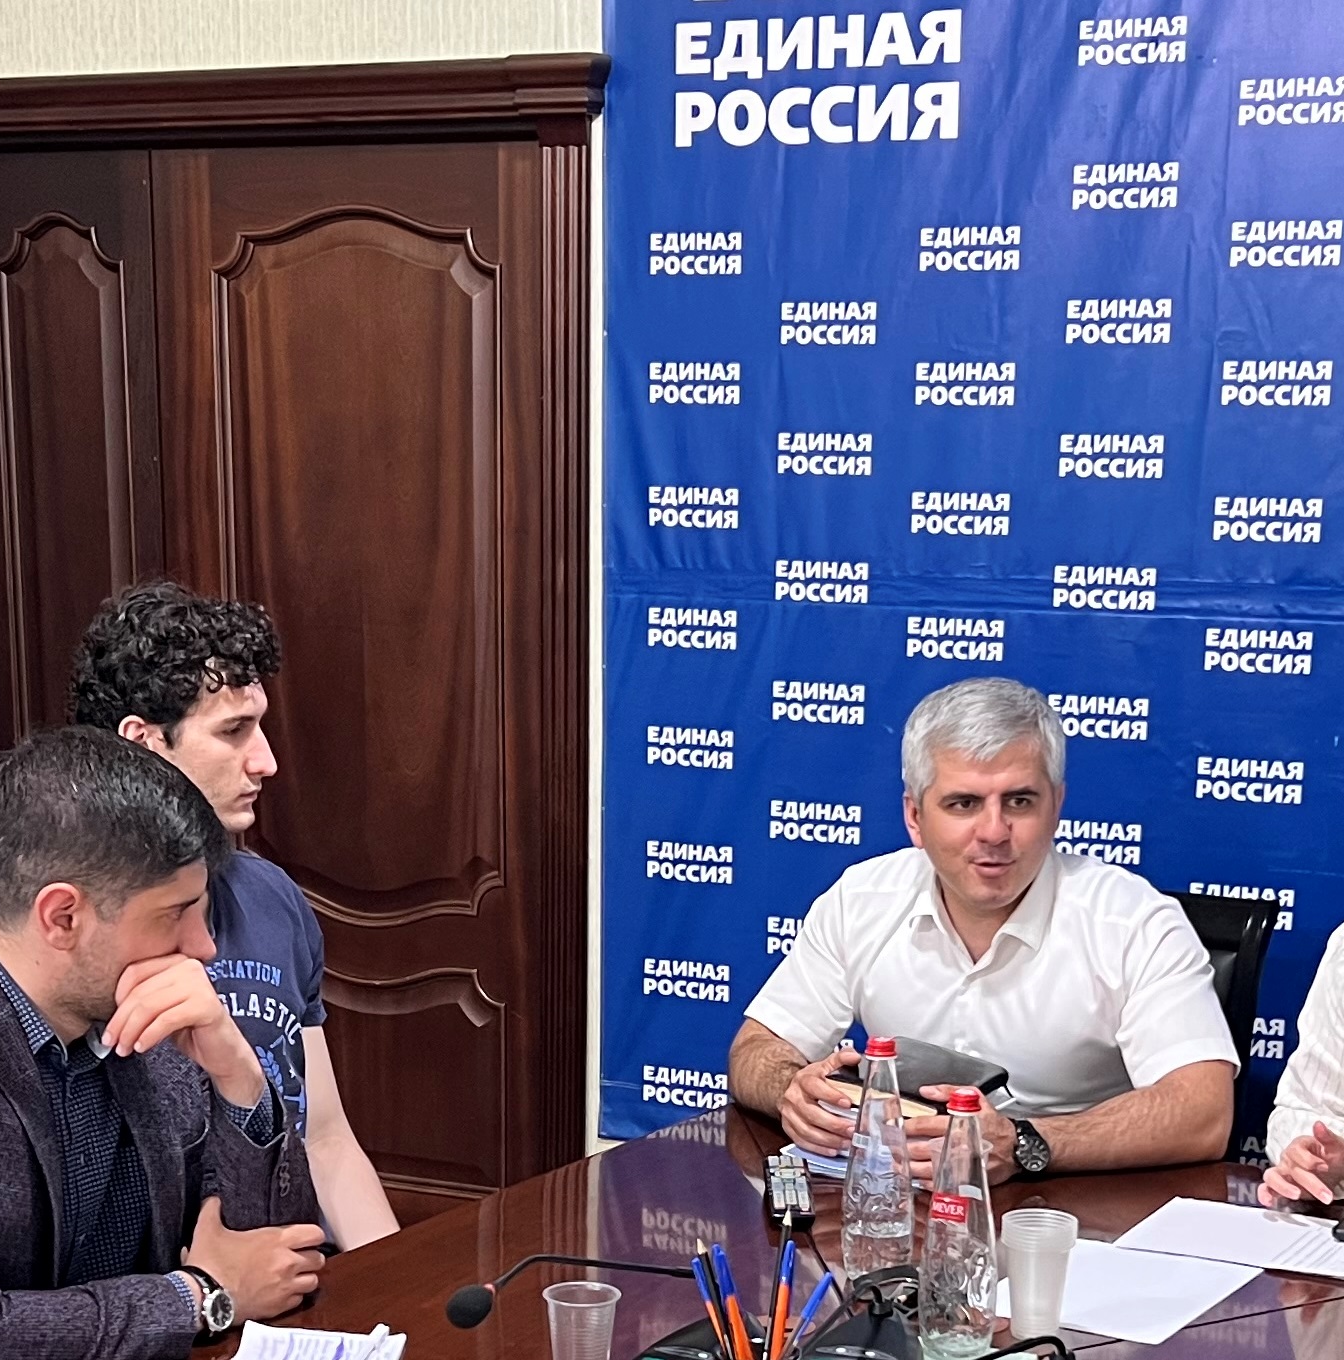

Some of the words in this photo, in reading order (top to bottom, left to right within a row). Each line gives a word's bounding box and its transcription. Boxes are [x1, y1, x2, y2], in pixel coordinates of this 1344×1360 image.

[1079, 15, 1188, 43] ЕДИНАЯ
[675, 8, 962, 81] ЕДИНАЯ
[1077, 40, 1187, 67] РОССИЯ
[675, 81, 960, 148] РОССИЯ
[1073, 161, 1180, 187] ЕДИНАЯ
[1072, 186, 1178, 211] РОССИЯ
[650, 232, 742, 254] ЕДИНАЯ
[920, 225, 1021, 249] ЕДИНАЯ
[1231, 219, 1343, 244] ЕДИНАЯ
[650, 254, 742, 275] РОССИЯ
[919, 249, 1020, 272] РОССИЯ
[1229, 244, 1341, 268] РОССИЯ
[781, 301, 877, 323] ЕДИНАЯ
[1066, 298, 1172, 322] ЕДИНАЯ
[780, 324, 876, 345] РОССИЯ
[1065, 322, 1171, 344] РОССИЯ
[649, 362, 741, 383] ЕДИНАЯ
[915, 362, 1016, 384] ЕДИНАЯ
[1222, 360, 1333, 383] ЕДИНАЯ
[649, 384, 740, 405] РОССИЯ
[915, 385, 1015, 406] РОССИЯ
[1221, 384, 1331, 406] РОССИЯ
[778, 432, 873, 454] ЕДИНАЯ
[1059, 434, 1165, 456] ЕДИНАЯ
[777, 455, 872, 476] РОССИЯ
[1058, 457, 1163, 479] РОССИЯ
[648, 486, 739, 507] ЕДИНАЯ
[911, 491, 1011, 513] ЕДИНАЯ
[1214, 496, 1323, 519] ЕДИНАЯ
[648, 507, 739, 529] РОССИЯ
[911, 514, 1009, 536] РОССИЯ
[1213, 520, 1321, 543] РОССИЯ
[775, 559, 869, 581] ЕДИНАЯ
[1053, 565, 1157, 587] ЕДИНАЯ
[775, 581, 868, 604] РОССИЯ
[1052, 588, 1156, 611] РОССИЯ
[648, 607, 737, 628] ЕДИНАЯ
[907, 616, 1005, 638] ЕДИНАЯ
[648, 628, 737, 650] РОССИЯ
[906, 638, 1004, 662] РОССИЯ
[1205, 628, 1313, 651] ЕДИНАЯ
[1204, 650, 1312, 675] РОССИЯ
[772, 681, 865, 703] ЕДИНАЯ
[772, 701, 864, 725] РОССИЯ
[1047, 694, 1149, 717] ЕДИНАЯ
[647, 725, 734, 748] ЕДИНАЯ
[1059, 717, 1148, 741] ОССИЯ
[647, 746, 733, 770] РОССИЯ
[1197, 756, 1304, 781] ЕДИНАЯ
[1195, 779, 1302, 805] РОССИЯ
[770, 800, 861, 823] ЕДИНАЯ
[769, 820, 860, 845] РОССИЯ
[1054, 819, 1142, 842] ДИНАЯ
[646, 840, 733, 863] ЕДИНАЯ
[1054, 841, 1141, 865] ОССИЯ
[646, 860, 733, 885] РОССИЯ
[644, 958, 730, 982] ЕДИНАЯ
[643, 977, 729, 1003] РОССИЯ
[643, 1065, 728, 1090] ЕДИНАЯ
[642, 1084, 728, 1110] РОССИЯ
